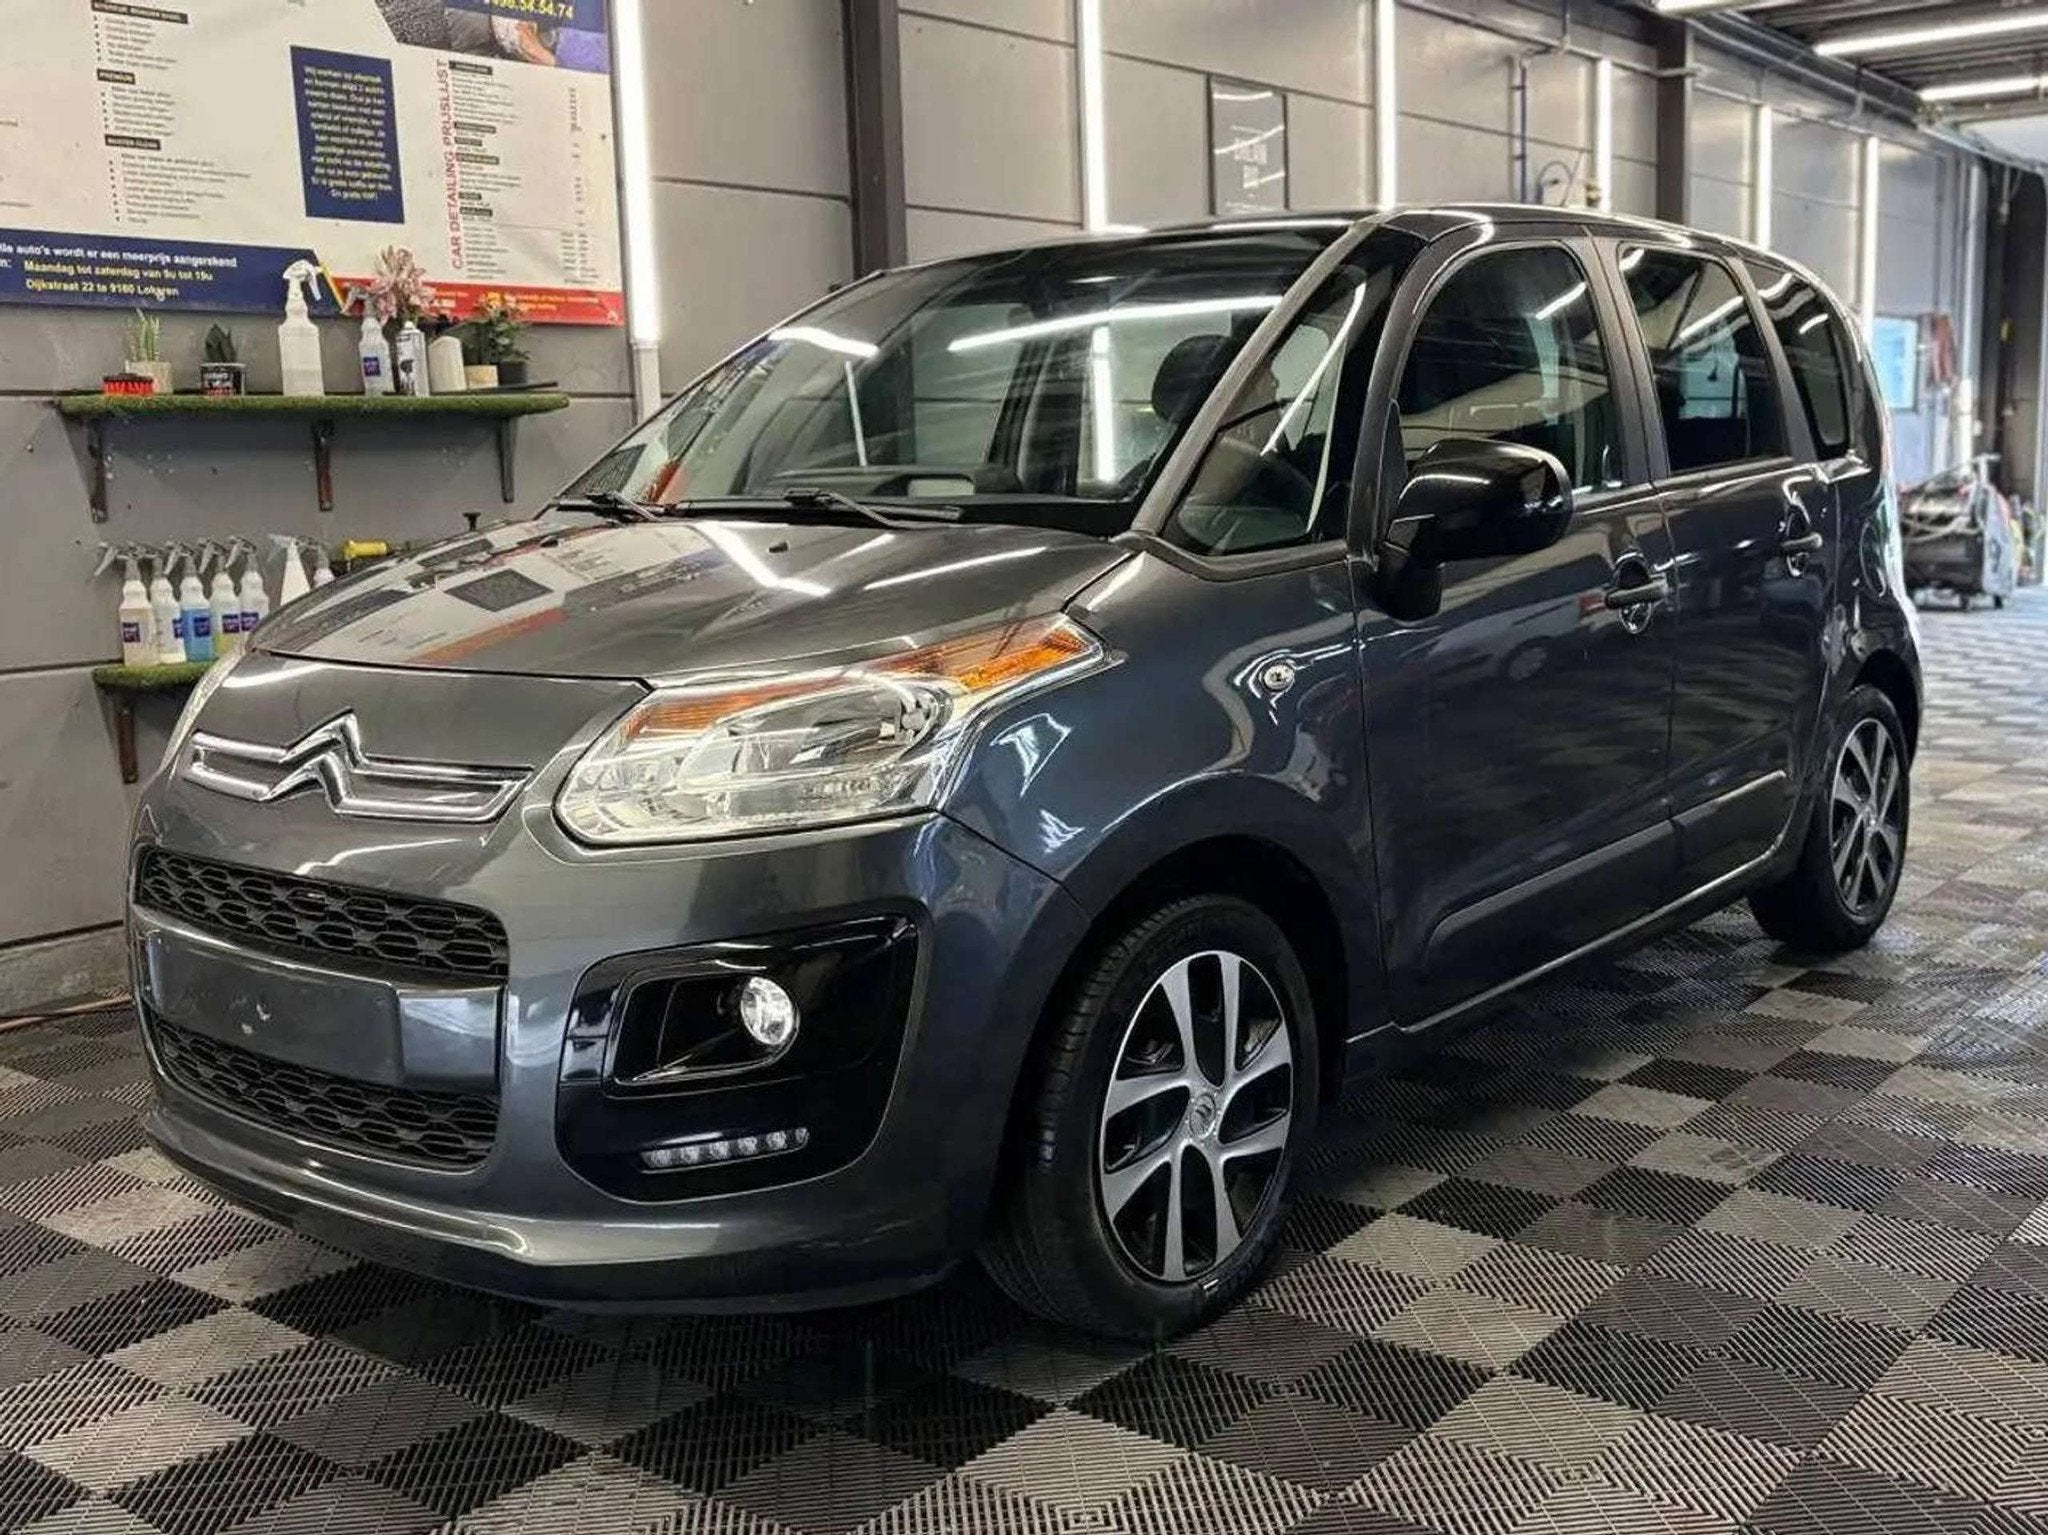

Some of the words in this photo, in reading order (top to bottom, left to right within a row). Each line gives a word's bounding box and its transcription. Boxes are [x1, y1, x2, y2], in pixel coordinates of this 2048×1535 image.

[444, 151, 461, 232] DETAILING
[450, 236, 463, 269] CAR
[24, 260, 75, 277] Maandag
[76, 264, 92, 275] tot
[95, 266, 140, 279] zaterdag
[141, 269, 161, 279] van
[26, 278, 79, 292] Dijkstraat
[81, 281, 94, 293] 22
